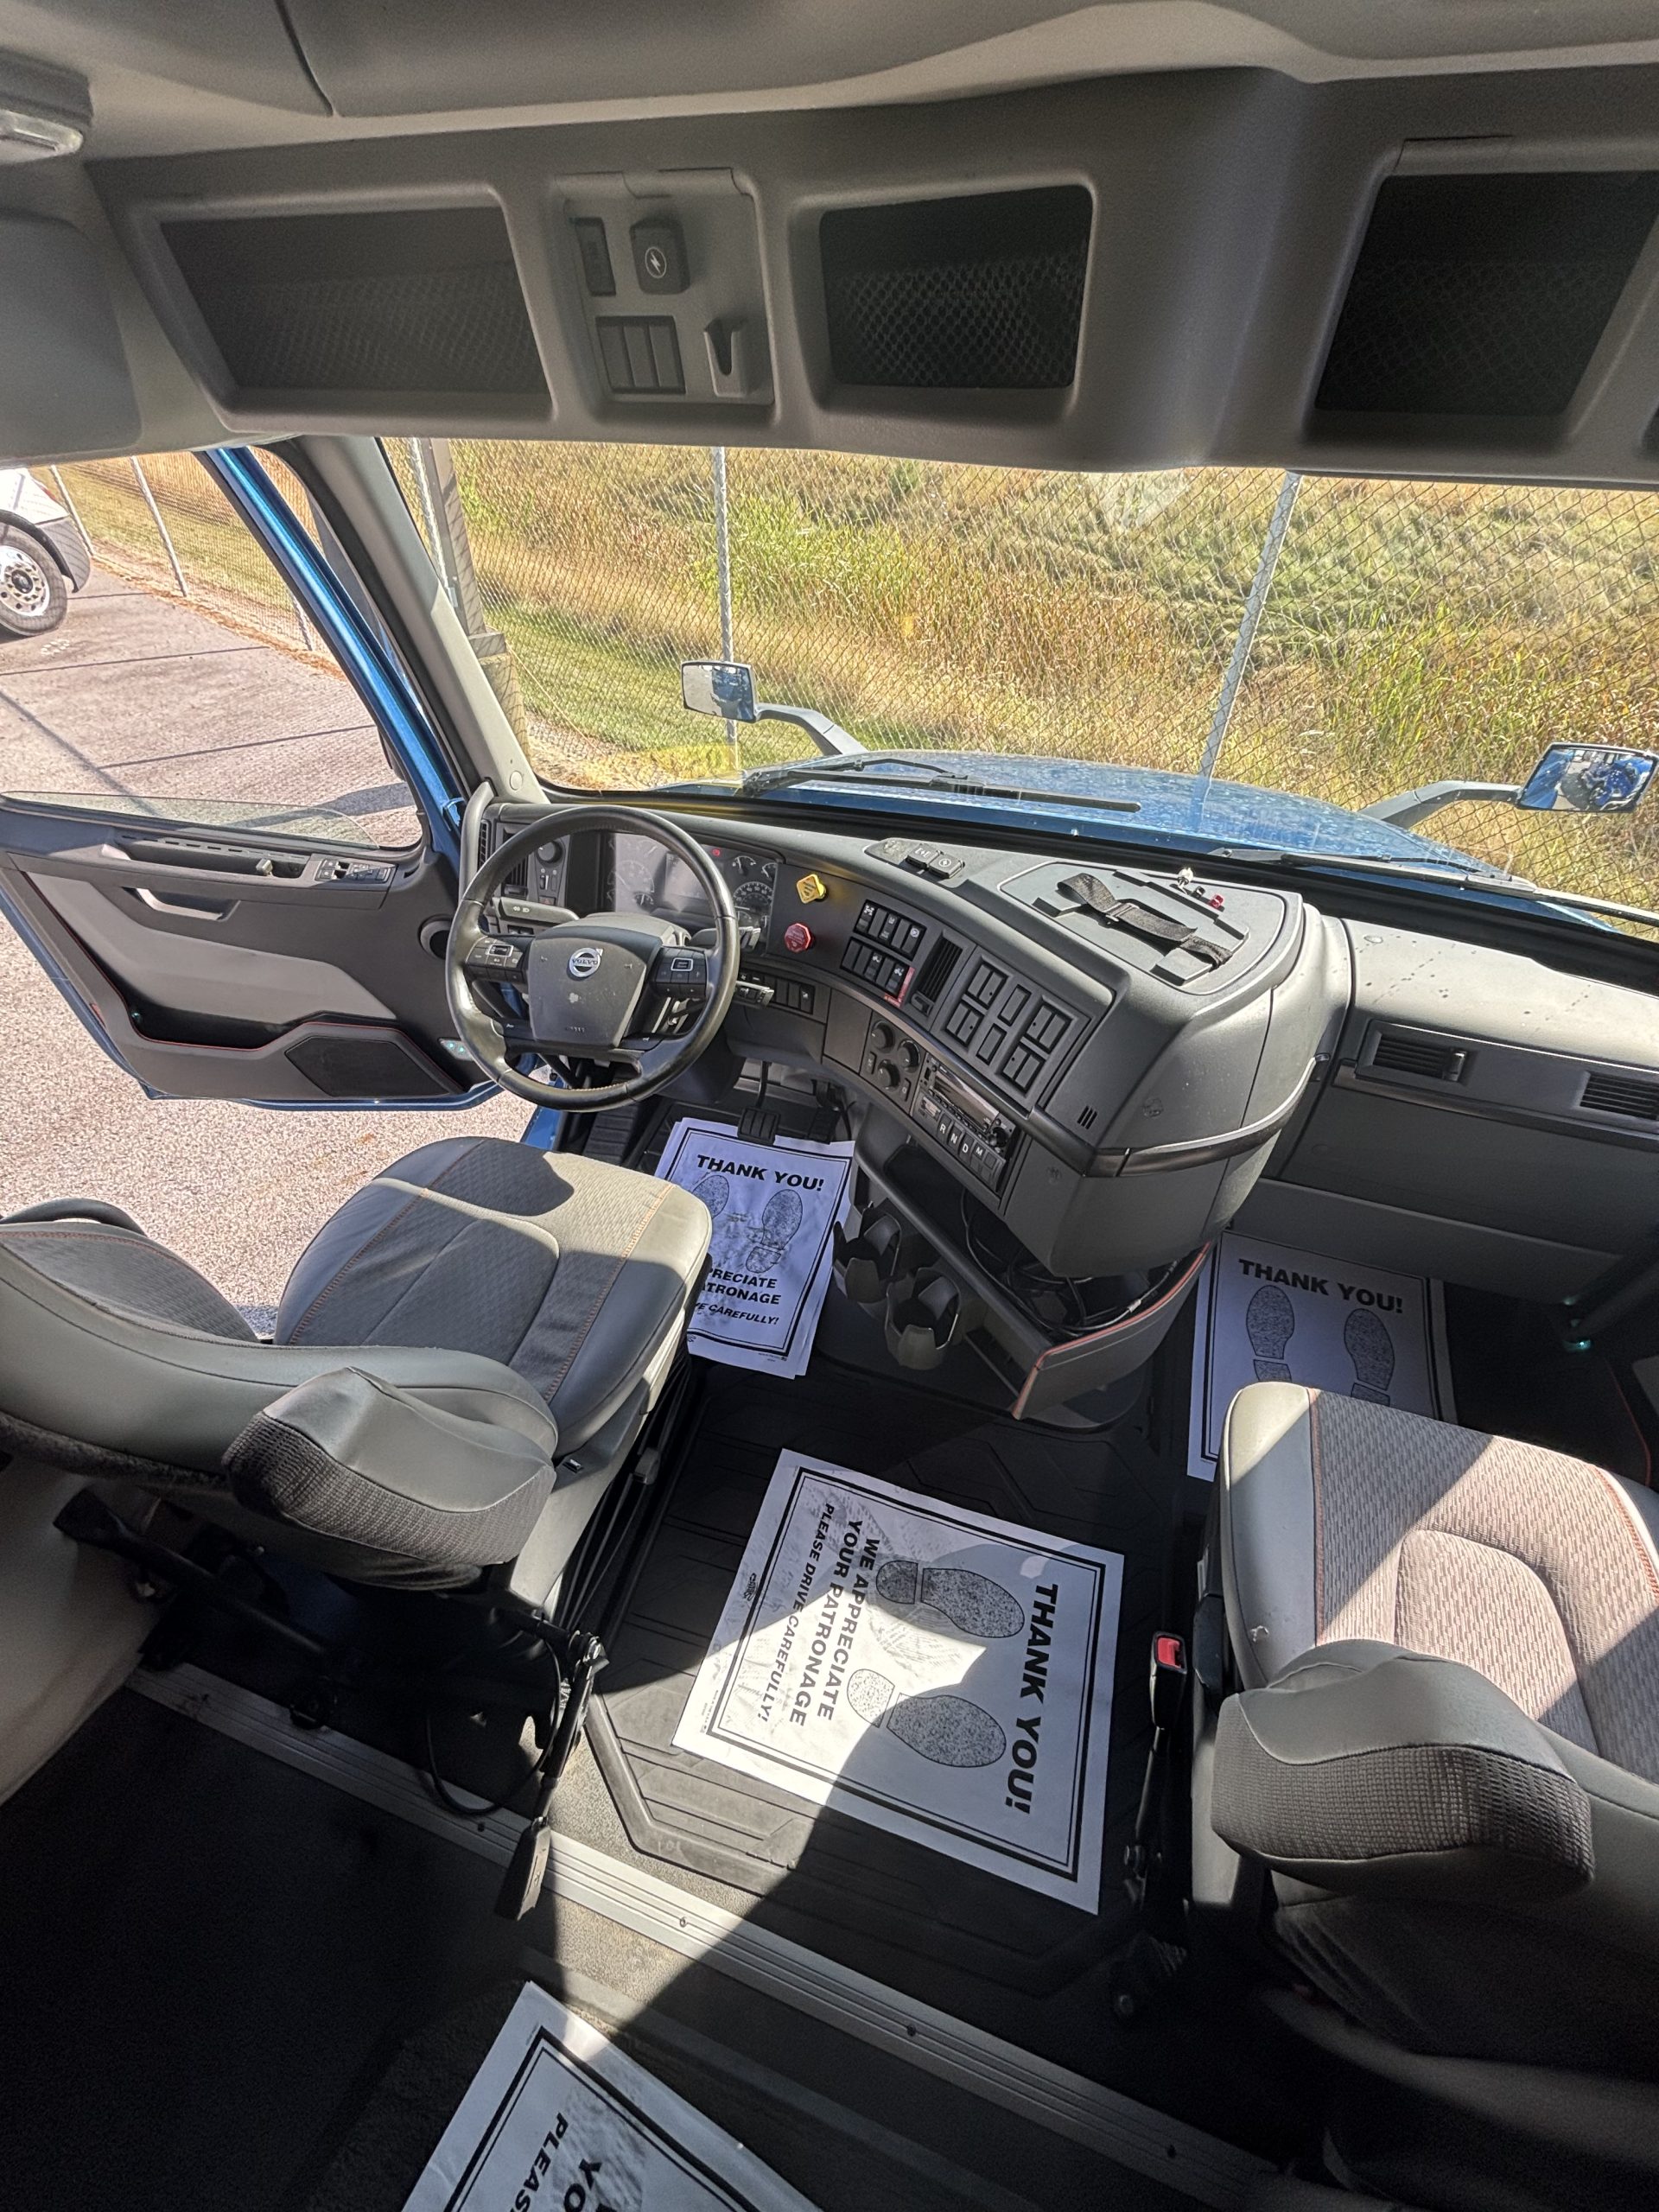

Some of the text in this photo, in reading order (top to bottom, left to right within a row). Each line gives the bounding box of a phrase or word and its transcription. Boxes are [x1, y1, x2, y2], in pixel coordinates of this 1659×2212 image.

[940, 1124, 983, 1156] R N D M
[697, 1154, 824, 1192] THANK YOU!
[703, 1282, 781, 1305] TRONAGE
[711, 1268, 777, 1288] RECIATE
[1238, 1258, 1403, 1314] THANK YOU!
[709, 1304, 779, 1325] CAREFULLY!
[757, 1503, 835, 1722] PLEASE DRIVE CAREFULLY!
[789, 1520, 863, 1726] YOUR PATRONAGE
[817, 1538, 880, 1721] WE APPRECIATE
[1005, 1584, 1058, 1815] THANK YOU!
[510, 2112, 569, 2212] PLEAS
